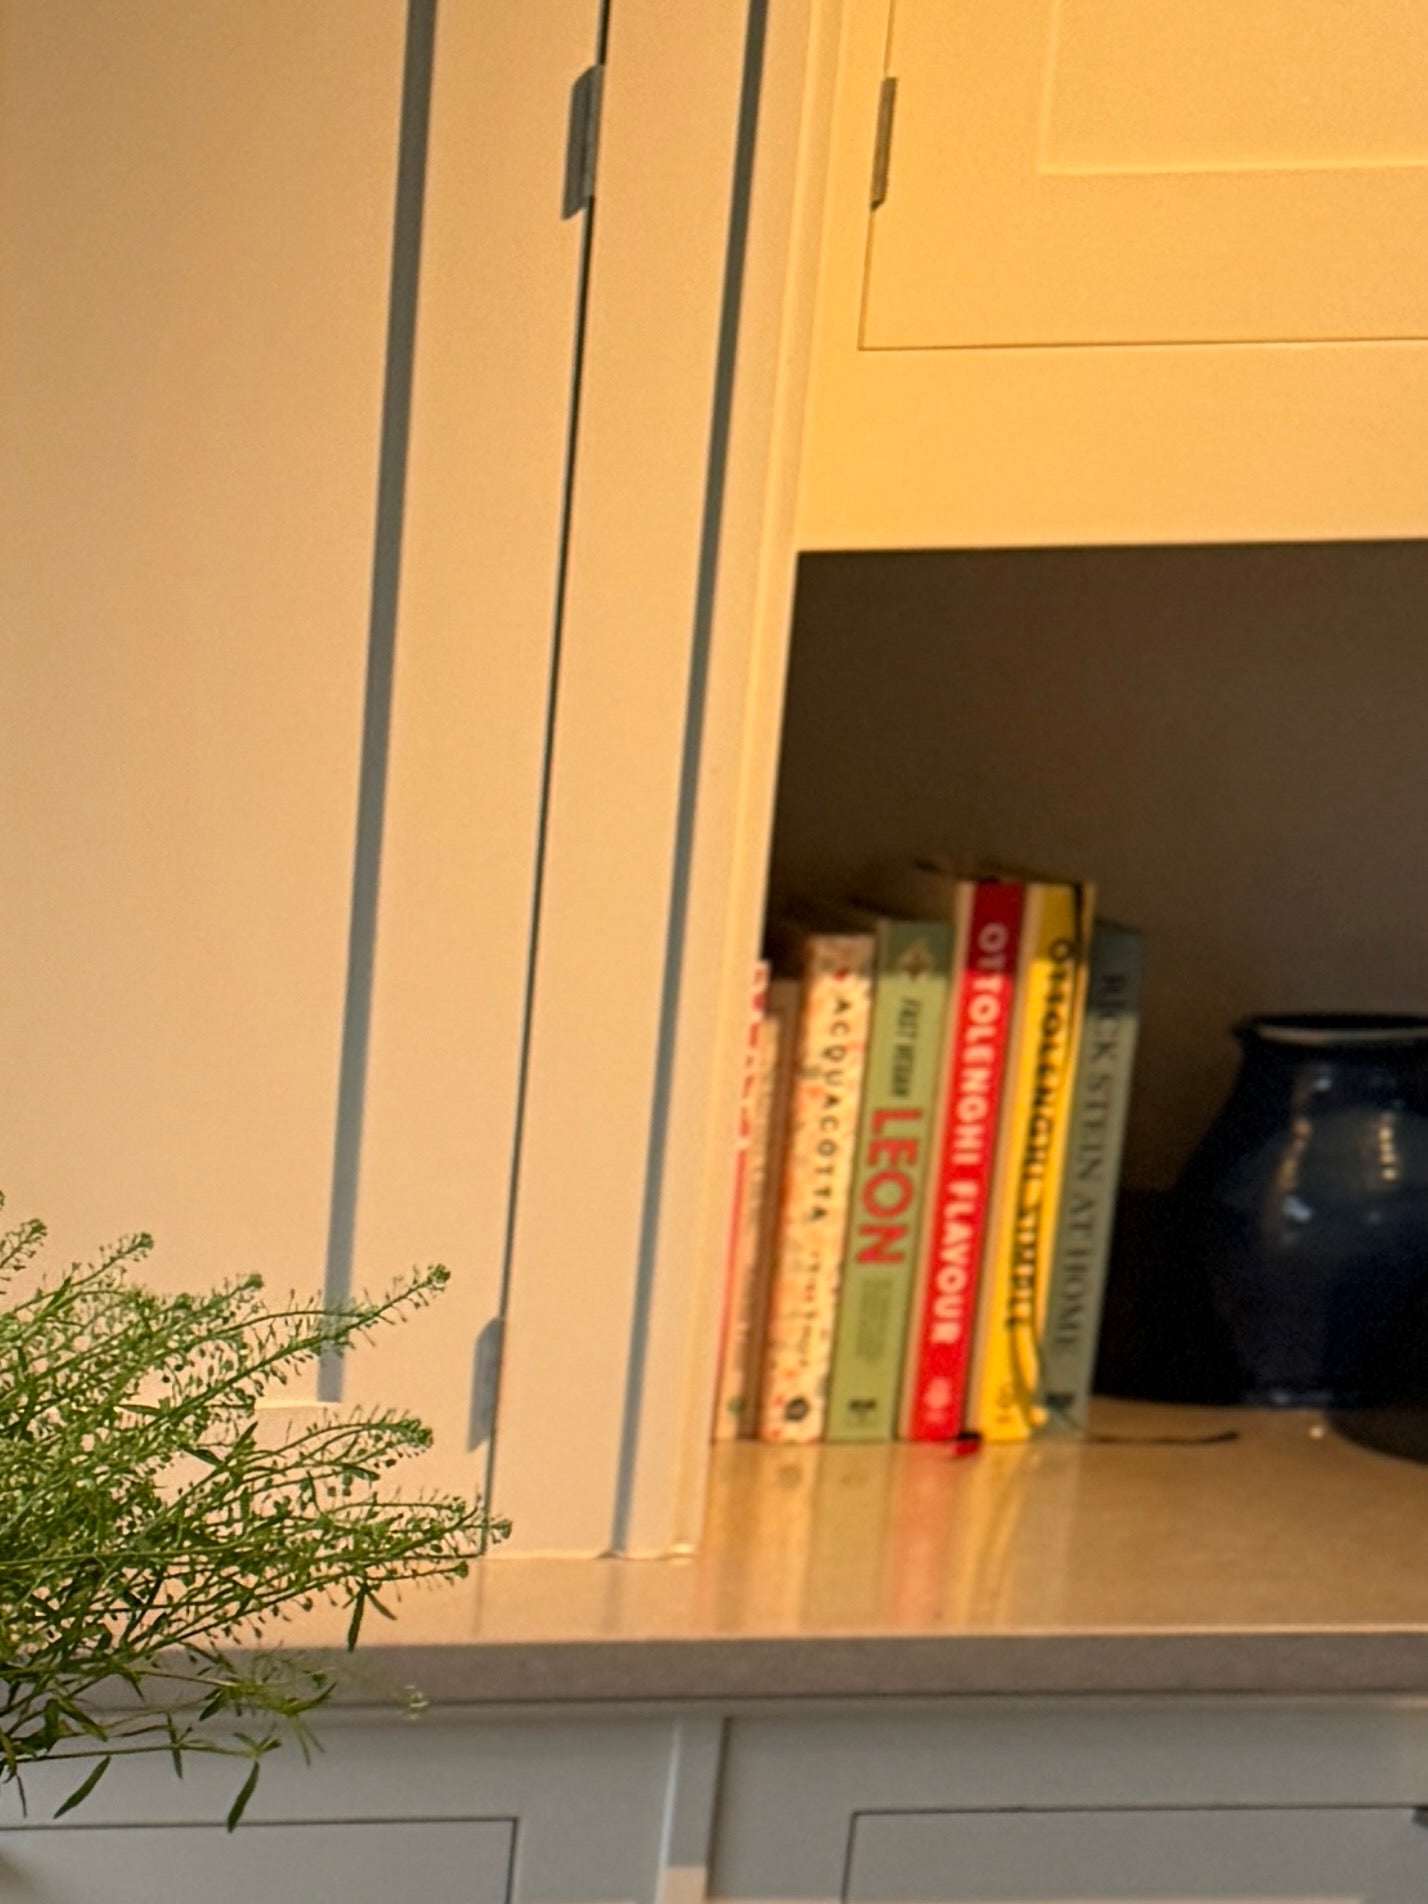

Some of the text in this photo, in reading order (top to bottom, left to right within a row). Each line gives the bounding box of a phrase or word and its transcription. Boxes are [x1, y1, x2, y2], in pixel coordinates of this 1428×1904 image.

[808, 997, 852, 1220] ACQUACOTTA
[950, 921, 1008, 1166] OTTOLENGHI
[854, 1107, 924, 1265] LEON
[930, 1179, 980, 1345] FLAVOUR
[1053, 973, 1127, 1347] RICK STEIN AT HOME
